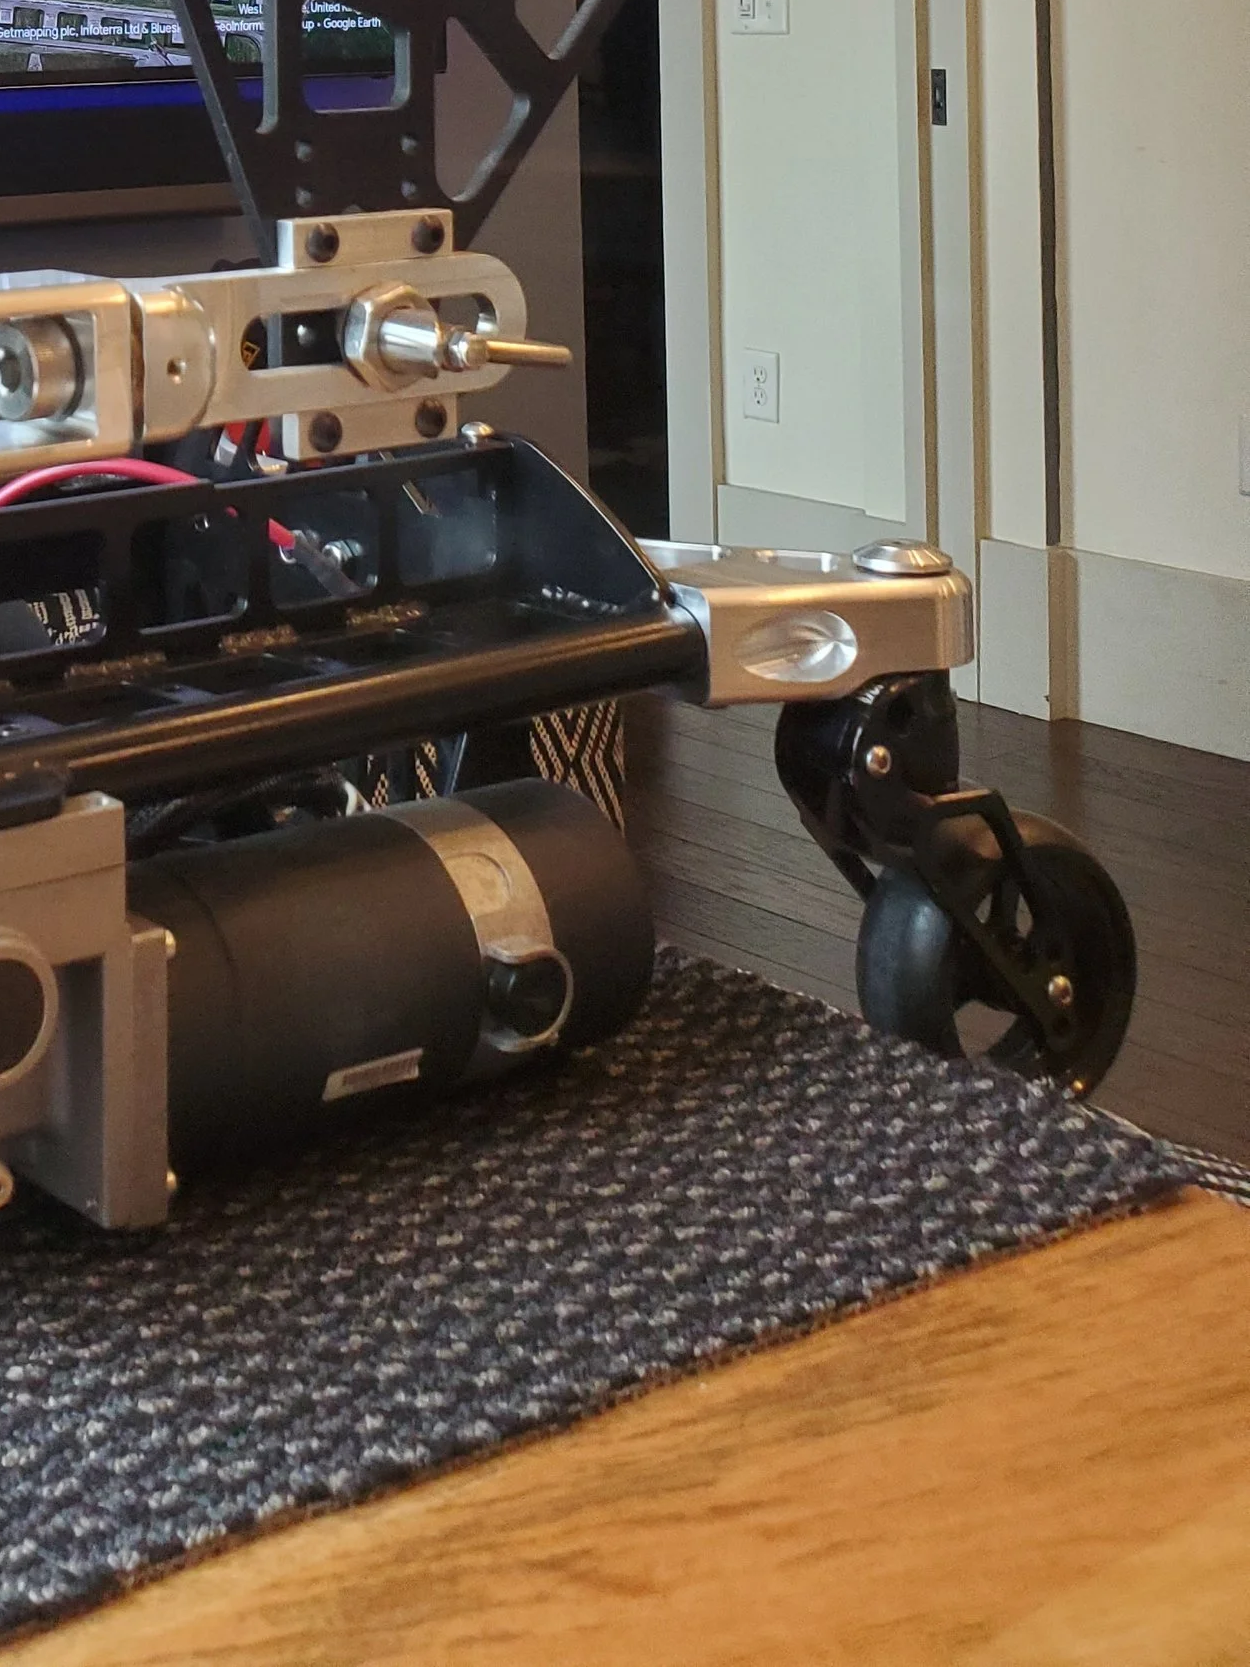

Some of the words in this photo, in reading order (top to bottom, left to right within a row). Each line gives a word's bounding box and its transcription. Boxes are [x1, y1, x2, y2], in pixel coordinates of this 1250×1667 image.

[310, 1, 340, 13] United
[60, 26, 79, 38] plc,
[80, 24, 123, 35] Infoterra
[124, 23, 140, 34] Ltd
[141, 23, 149, 34] &
[301, 20, 315, 32] up
[323, 17, 356, 31] Google
[357, 16, 381, 28] Earth
